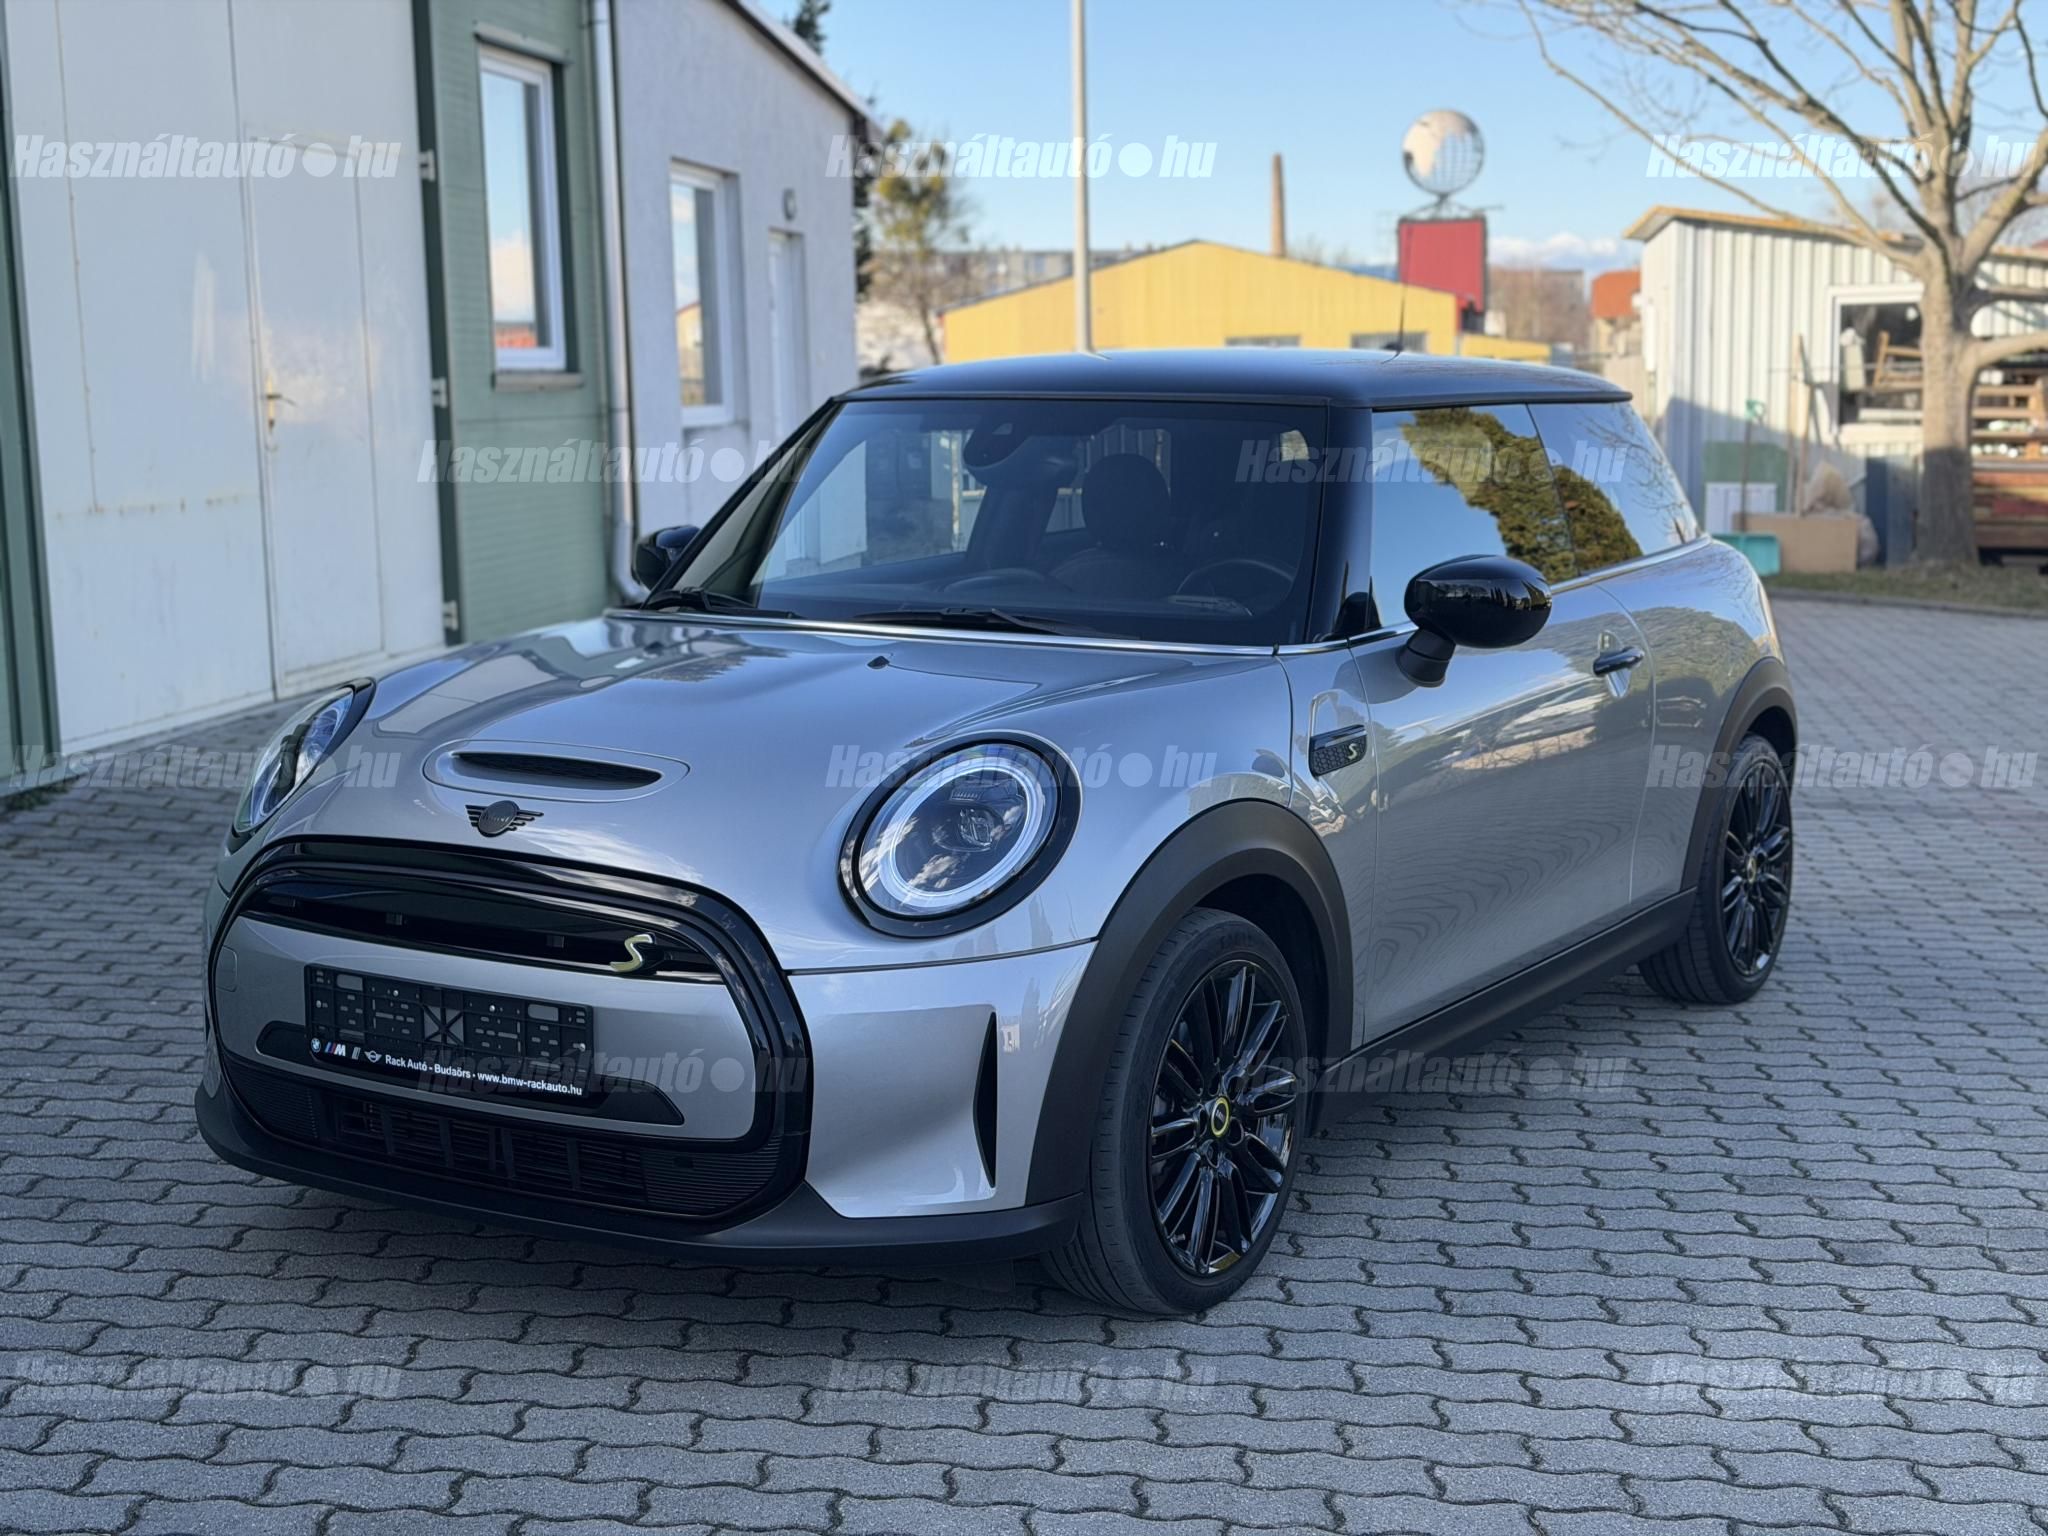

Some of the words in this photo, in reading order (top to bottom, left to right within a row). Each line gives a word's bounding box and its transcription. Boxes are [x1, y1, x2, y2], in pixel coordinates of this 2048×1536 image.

[1347, 743, 1358, 760] S
[609, 933, 653, 972] S
[385, 1054, 406, 1068] Rack
[407, 1058, 428, 1072] Autó
[434, 1063, 471, 1079] Budaörs
[477, 1072, 583, 1096] www.bmw-rackauto.hu
